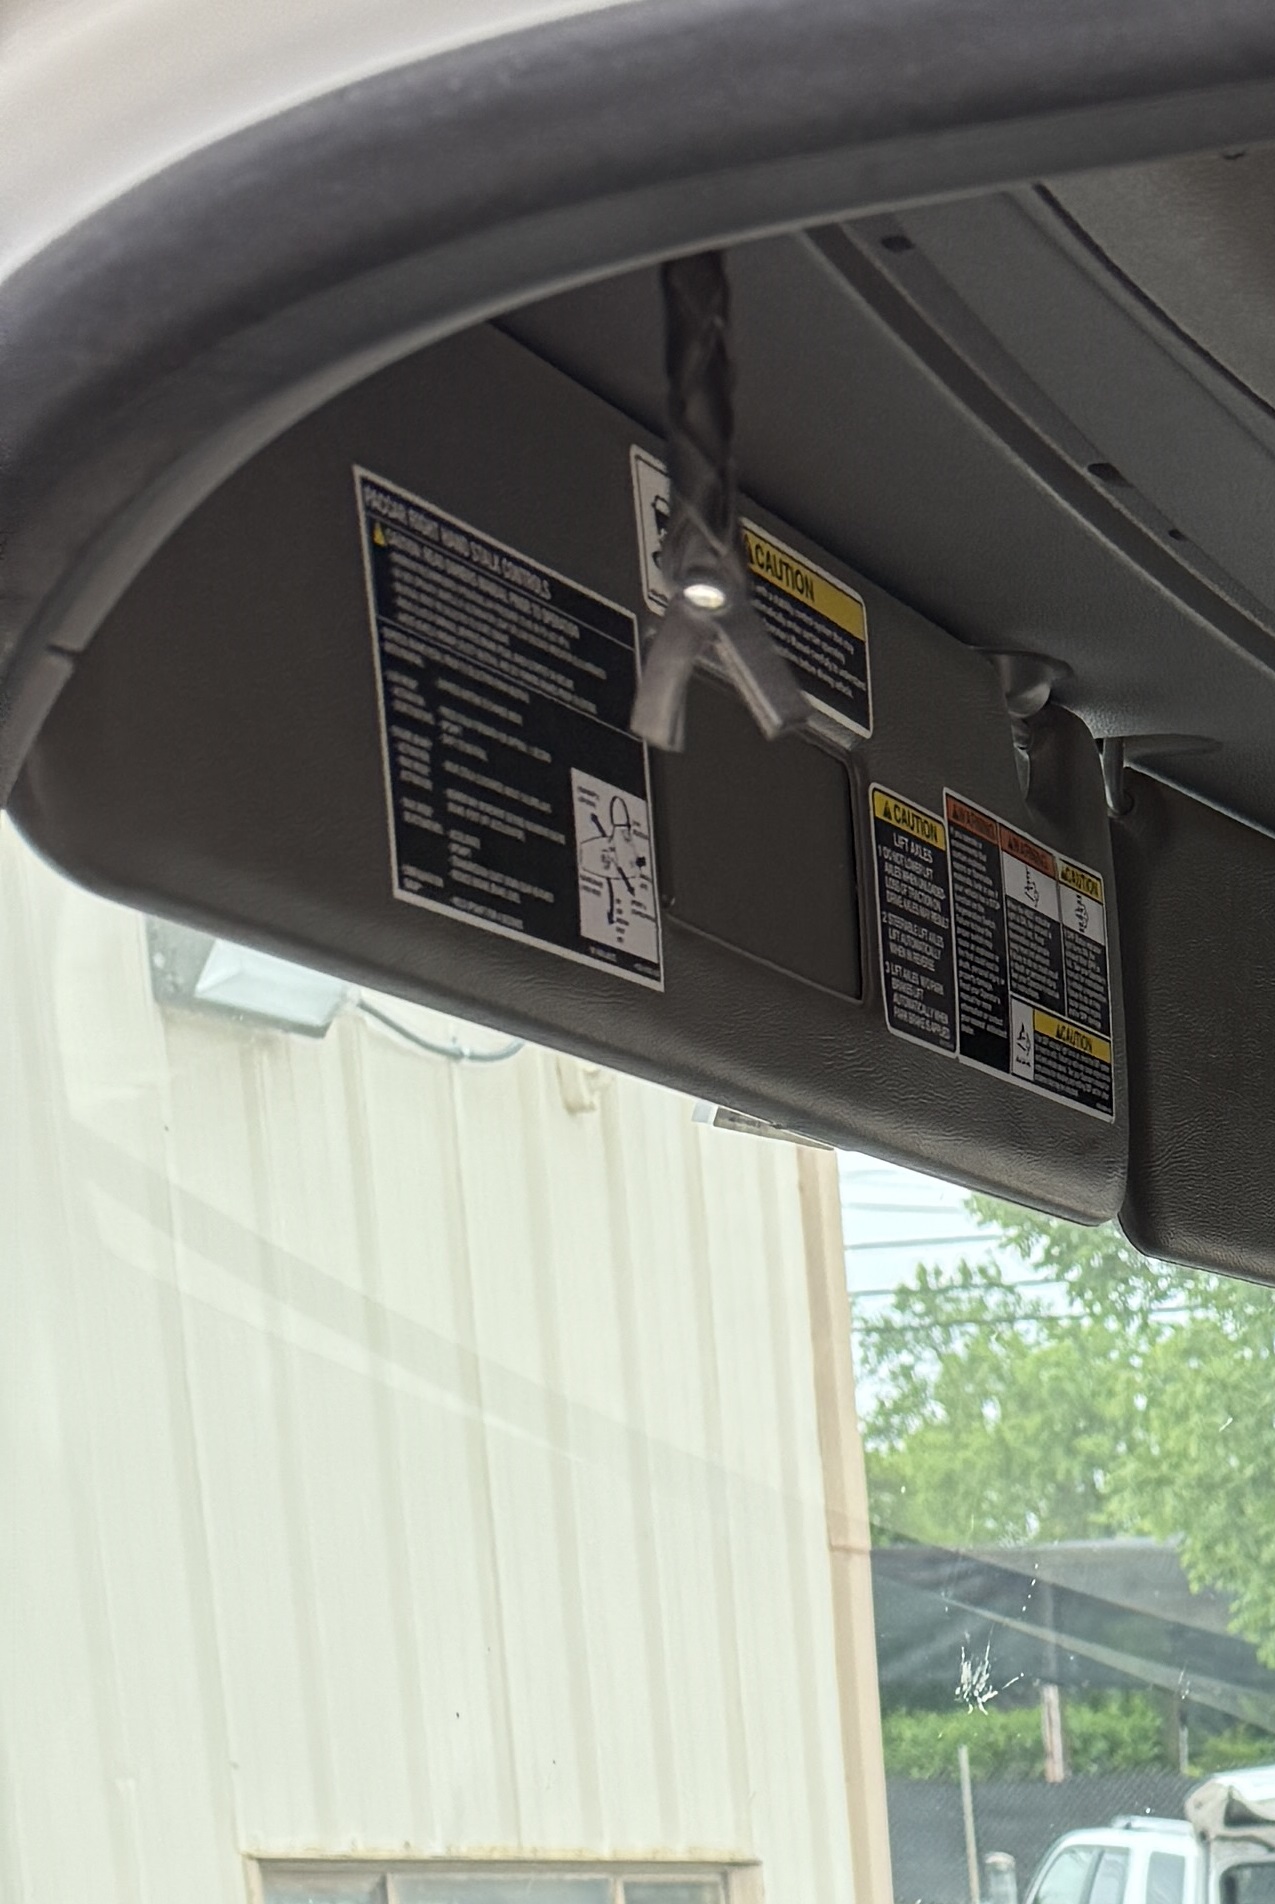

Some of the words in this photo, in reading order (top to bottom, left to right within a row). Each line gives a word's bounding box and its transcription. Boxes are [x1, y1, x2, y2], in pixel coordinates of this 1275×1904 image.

[755, 544, 815, 602] CAUTION
[893, 802, 938, 843] CAUTION
[1061, 1024, 1092, 1054] CAUTION
